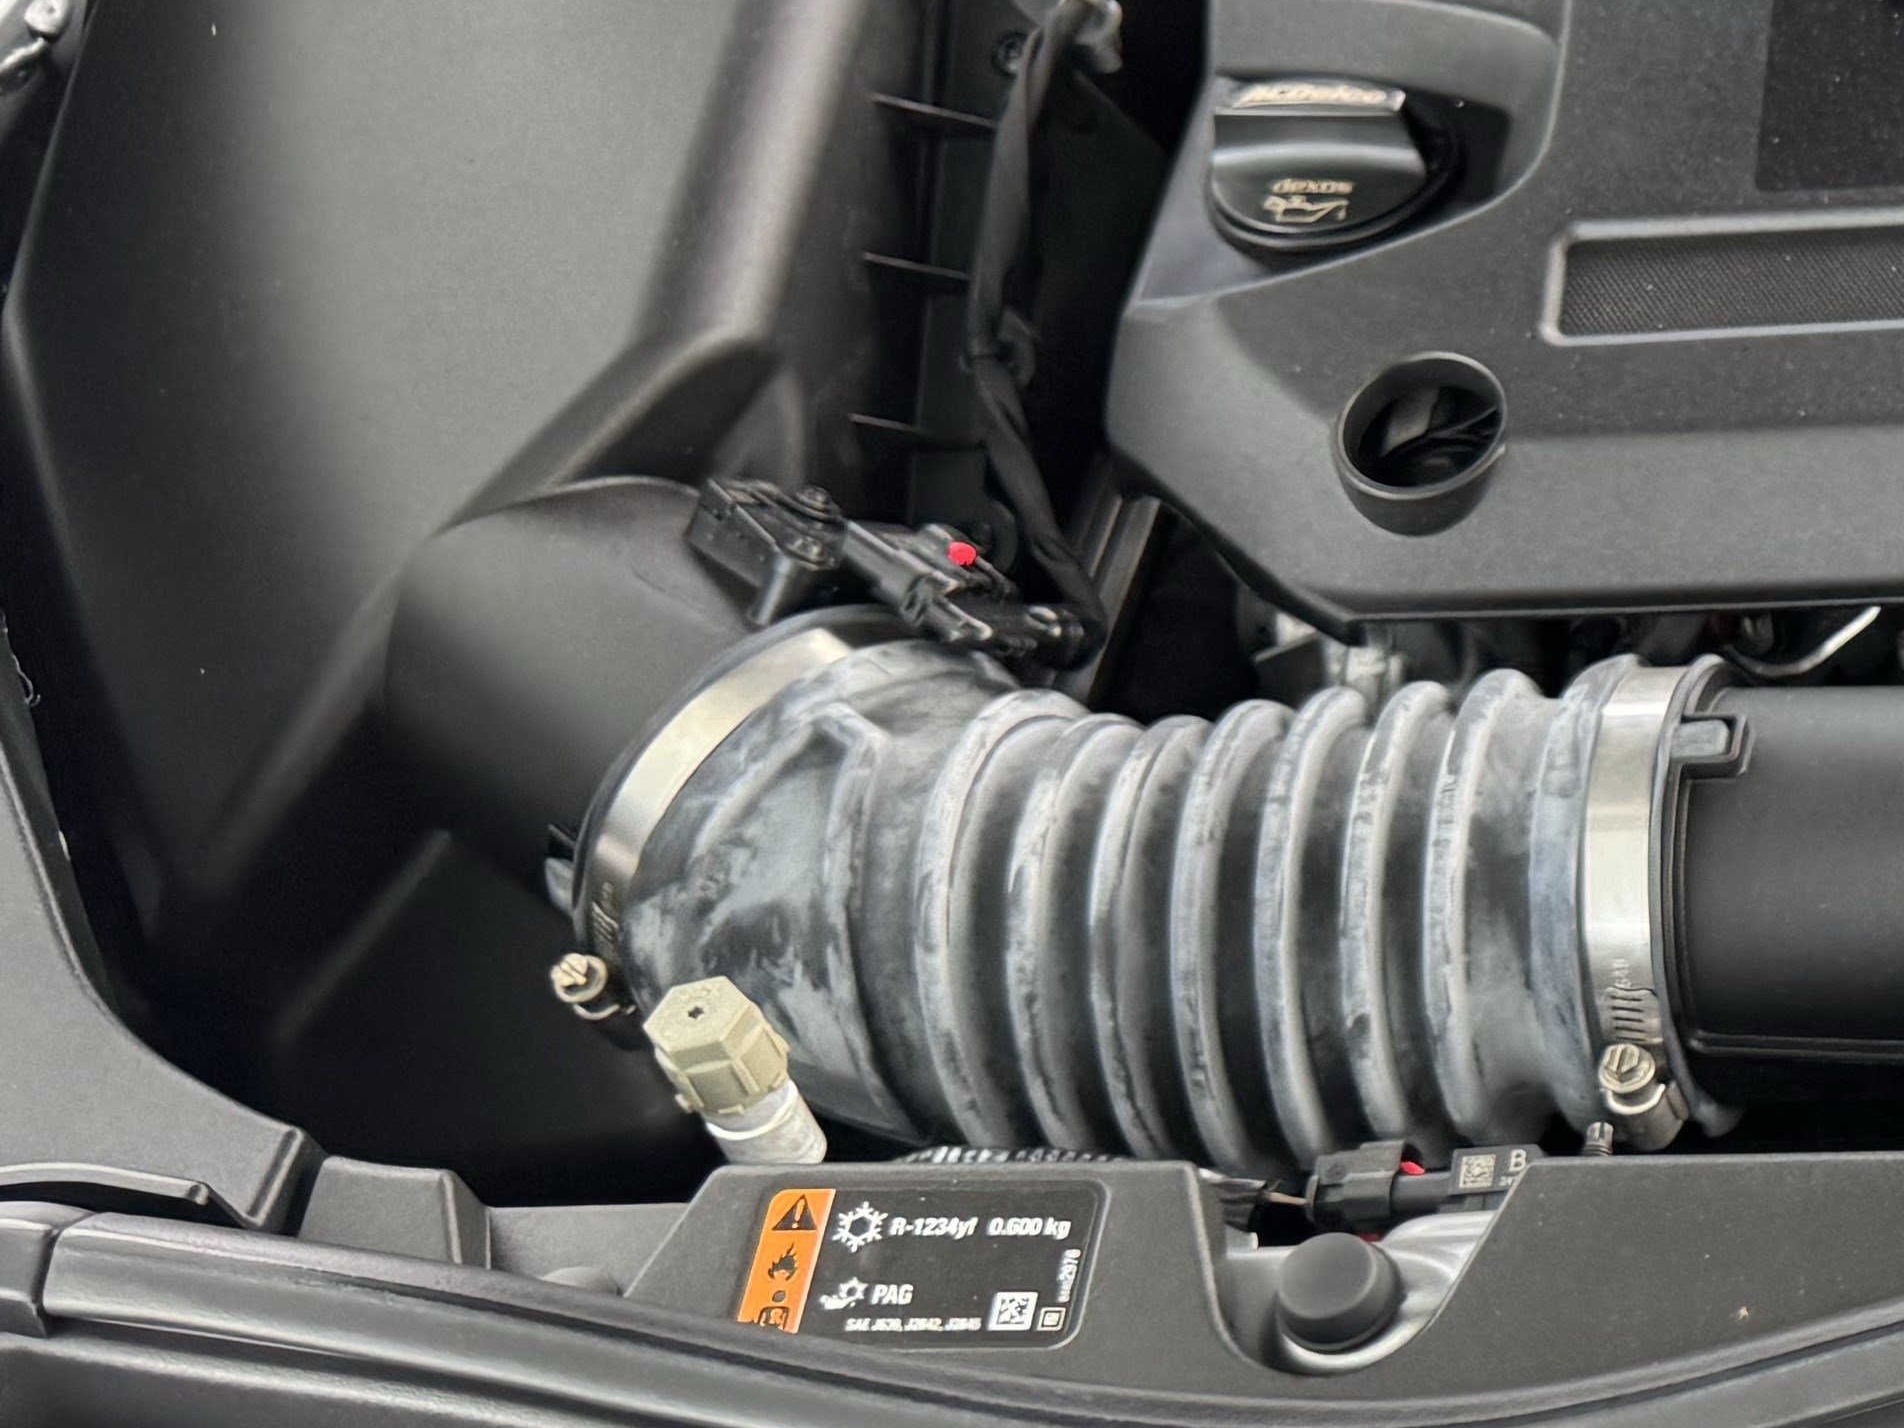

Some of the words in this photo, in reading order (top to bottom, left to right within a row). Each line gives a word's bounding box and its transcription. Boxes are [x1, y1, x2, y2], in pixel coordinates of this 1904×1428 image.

[889, 1216, 979, 1241] R-1234yf
[1042, 1216, 1072, 1240] kg
[871, 1283, 914, 1306] PAG
